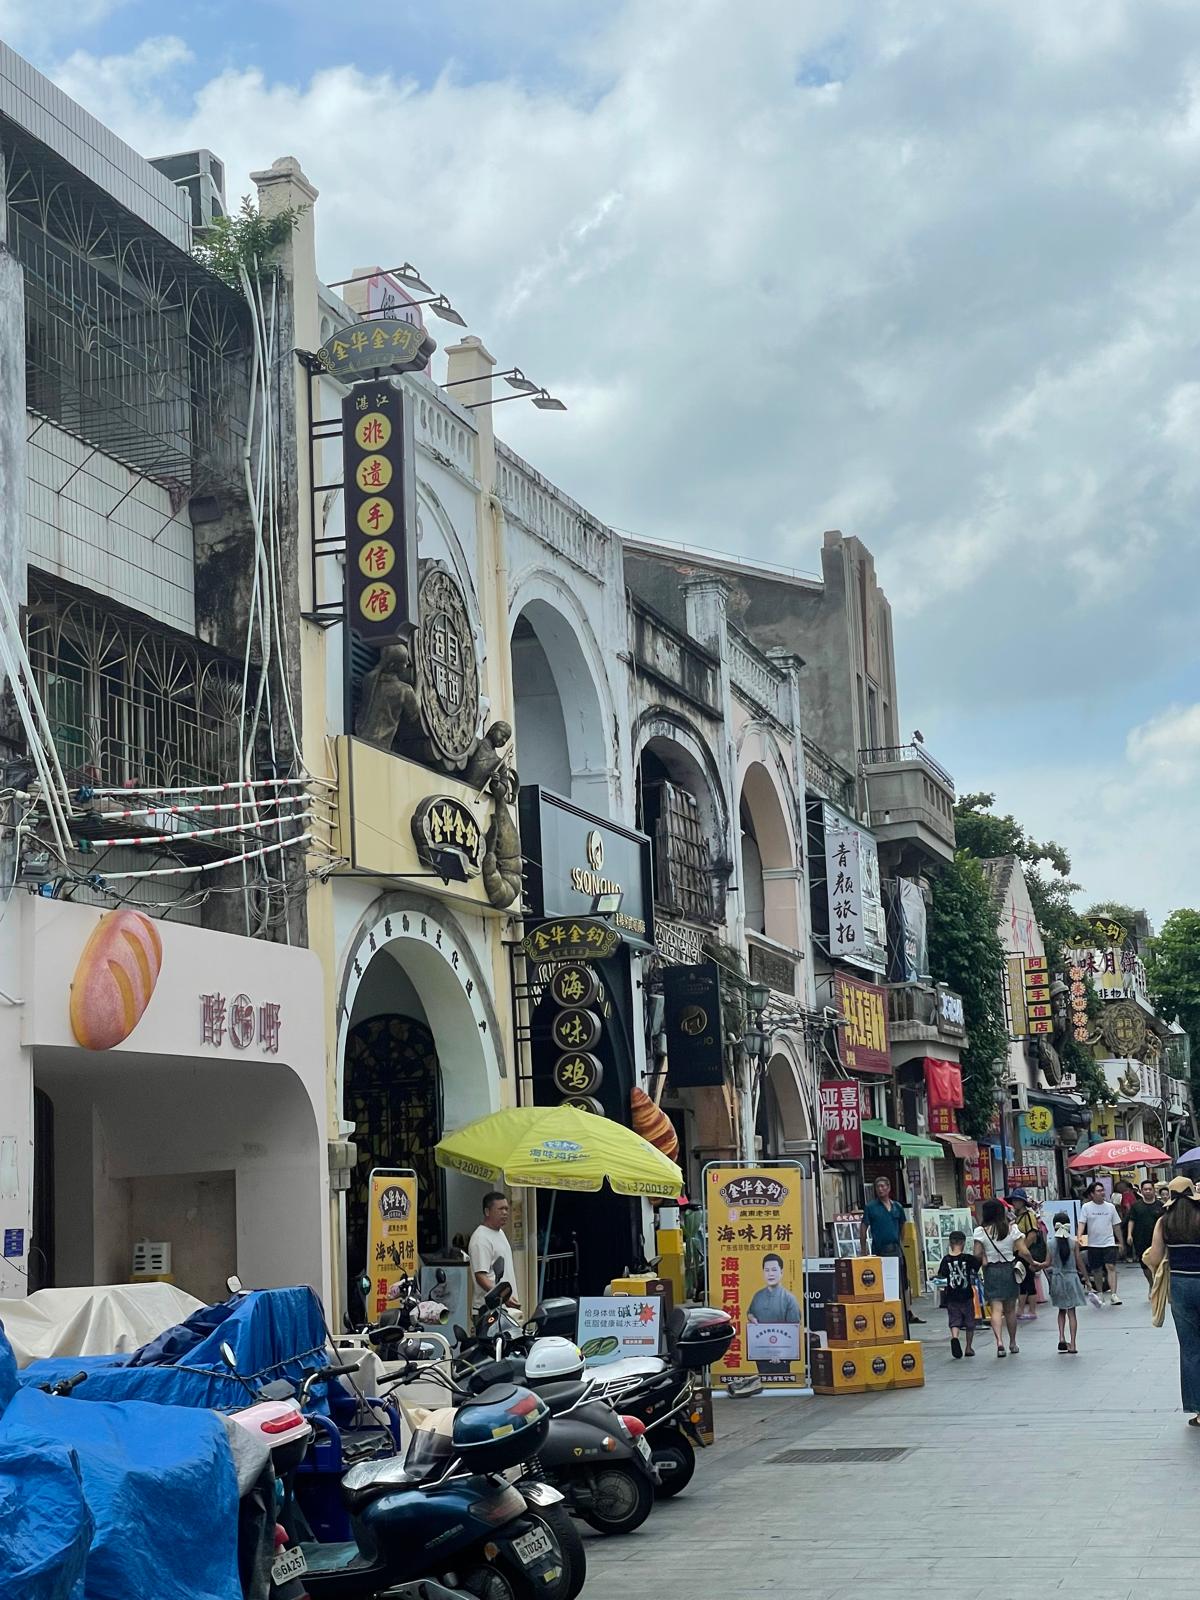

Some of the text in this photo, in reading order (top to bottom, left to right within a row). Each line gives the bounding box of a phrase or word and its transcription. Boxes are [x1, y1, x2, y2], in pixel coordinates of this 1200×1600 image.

[356, 394, 389, 410] 湛江
[361, 420, 391, 614] 非遗手信馆
[832, 842, 857, 944] 青颜旅拍
[1028, 958, 1048, 1032] 阿婆手信店
[559, 971, 589, 1113] 海味鸡
[822, 1109, 858, 1131] 肠粉
[457, 1158, 494, 1180] 3200187
[633, 1181, 674, 1196] 3200187
[717, 1224, 793, 1243] 海味月饼
[720, 1257, 742, 1368] 海味月饼者
